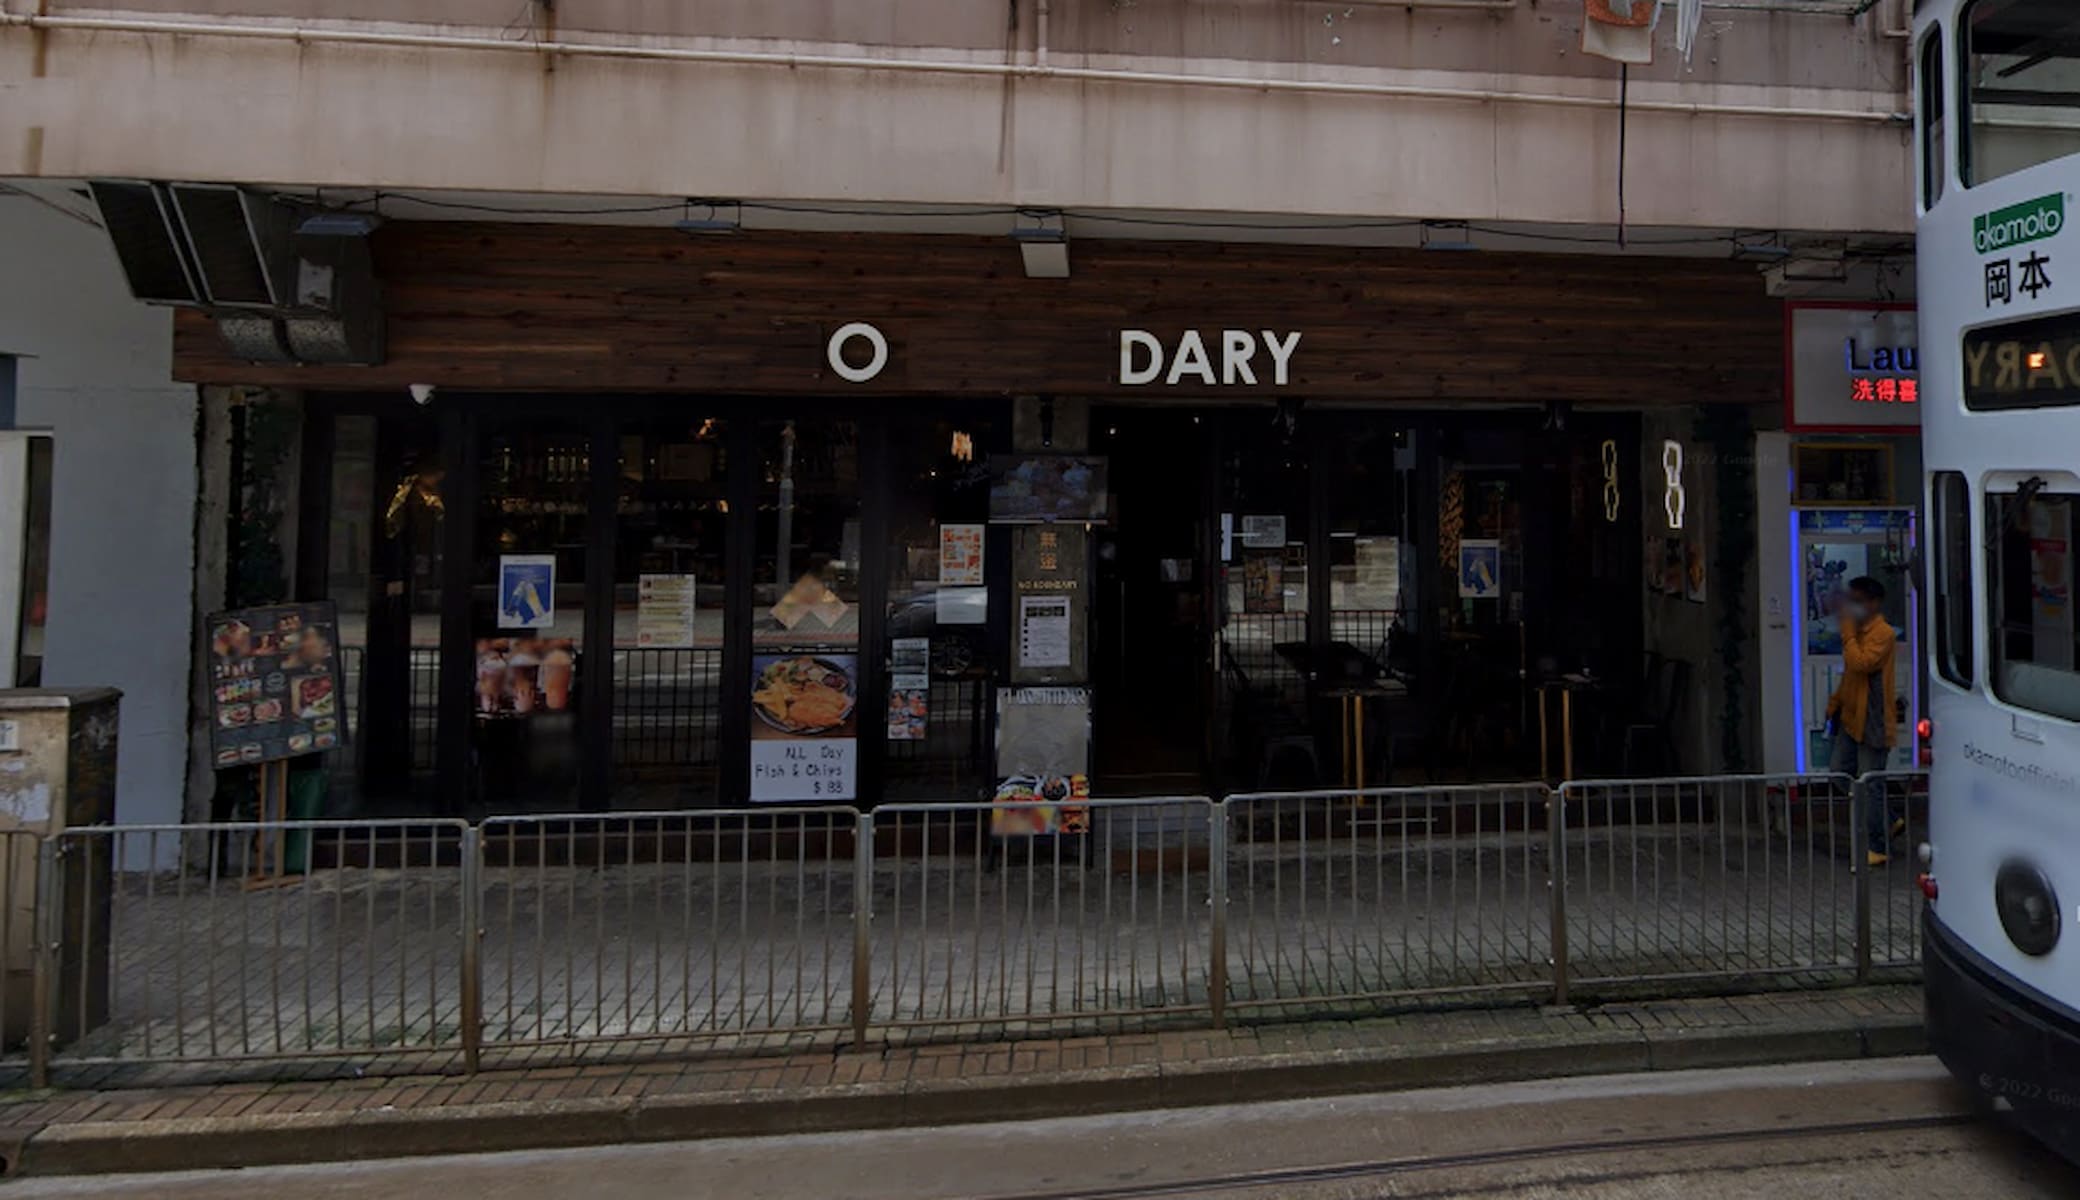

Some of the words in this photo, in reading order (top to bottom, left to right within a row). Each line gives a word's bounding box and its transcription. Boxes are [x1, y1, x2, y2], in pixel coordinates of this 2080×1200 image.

[1976, 206, 2062, 252] okamoto
[1984, 250, 2052, 308] 岡本
[827, 323, 887, 382] O
[1119, 330, 1302, 386] DARY
[1846, 337, 1918, 372] Lau
